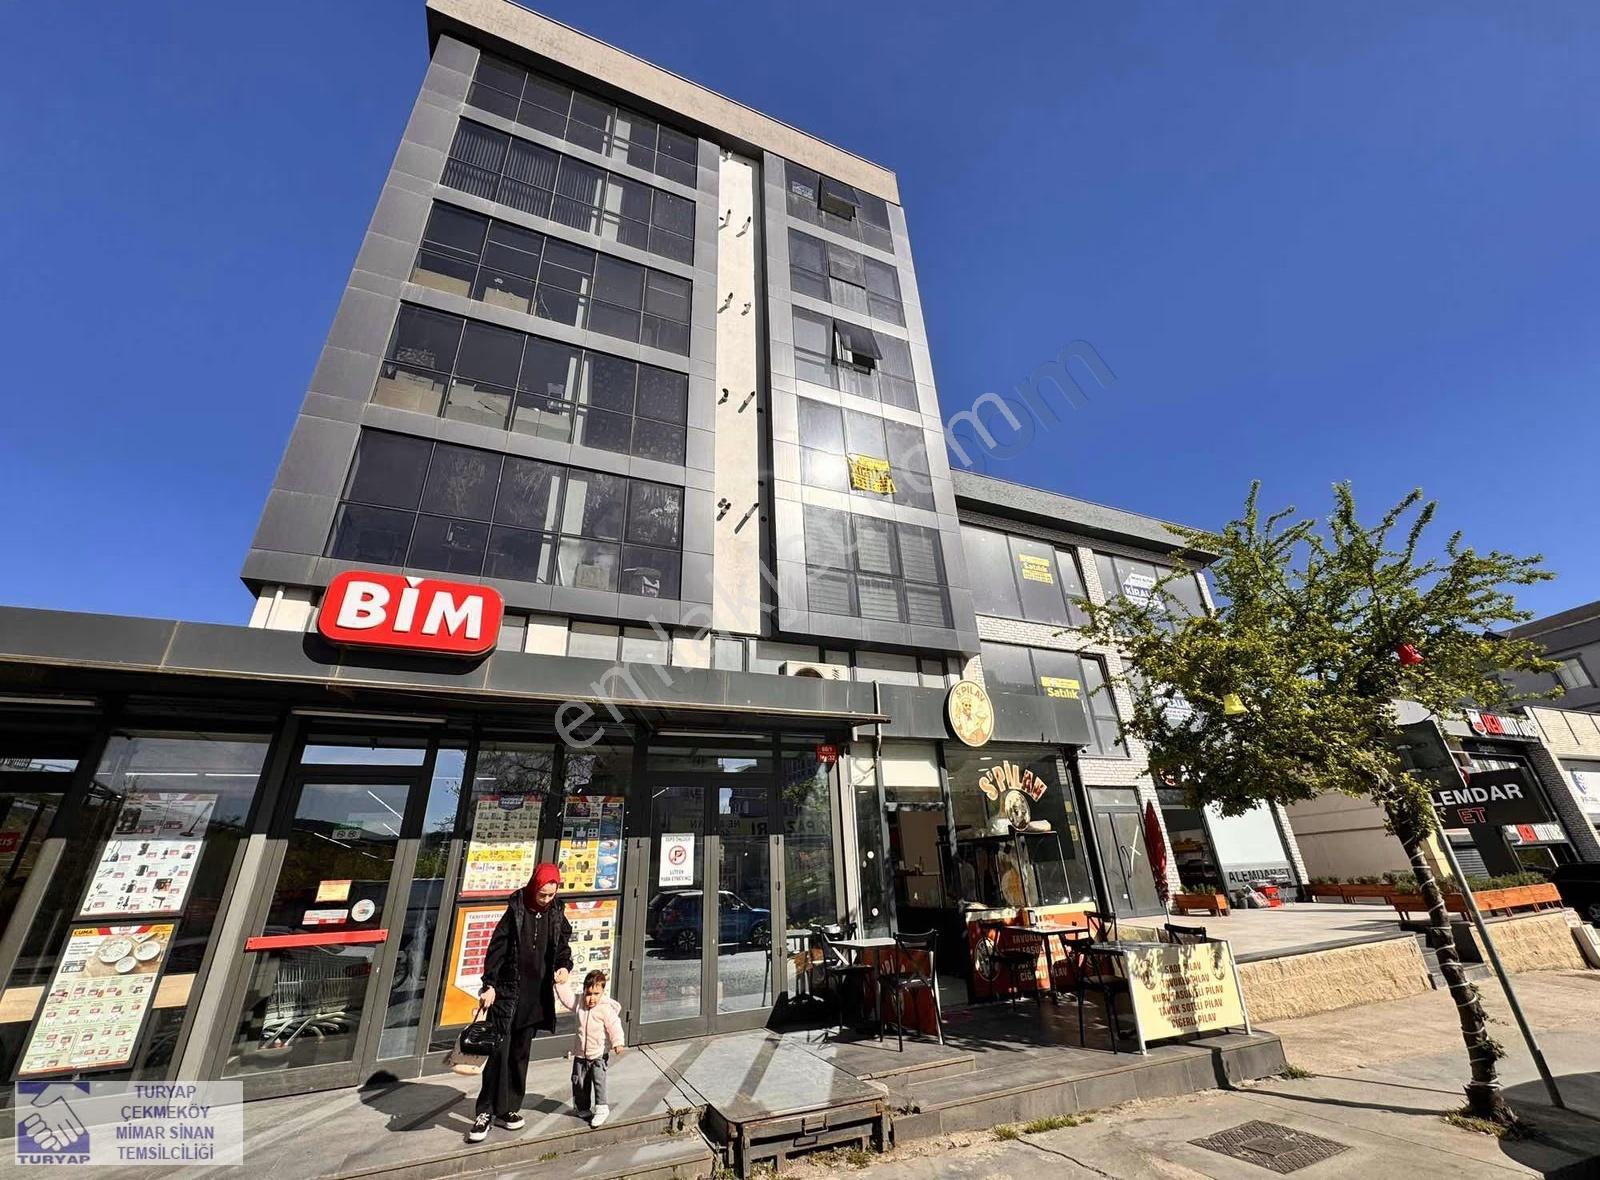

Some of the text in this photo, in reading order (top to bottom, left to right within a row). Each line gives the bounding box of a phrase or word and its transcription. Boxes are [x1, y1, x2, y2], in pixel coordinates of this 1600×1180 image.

[336, 576, 483, 640] BİM
[1047, 687, 1080, 700] Satılık
[1457, 807, 1487, 825] ET
